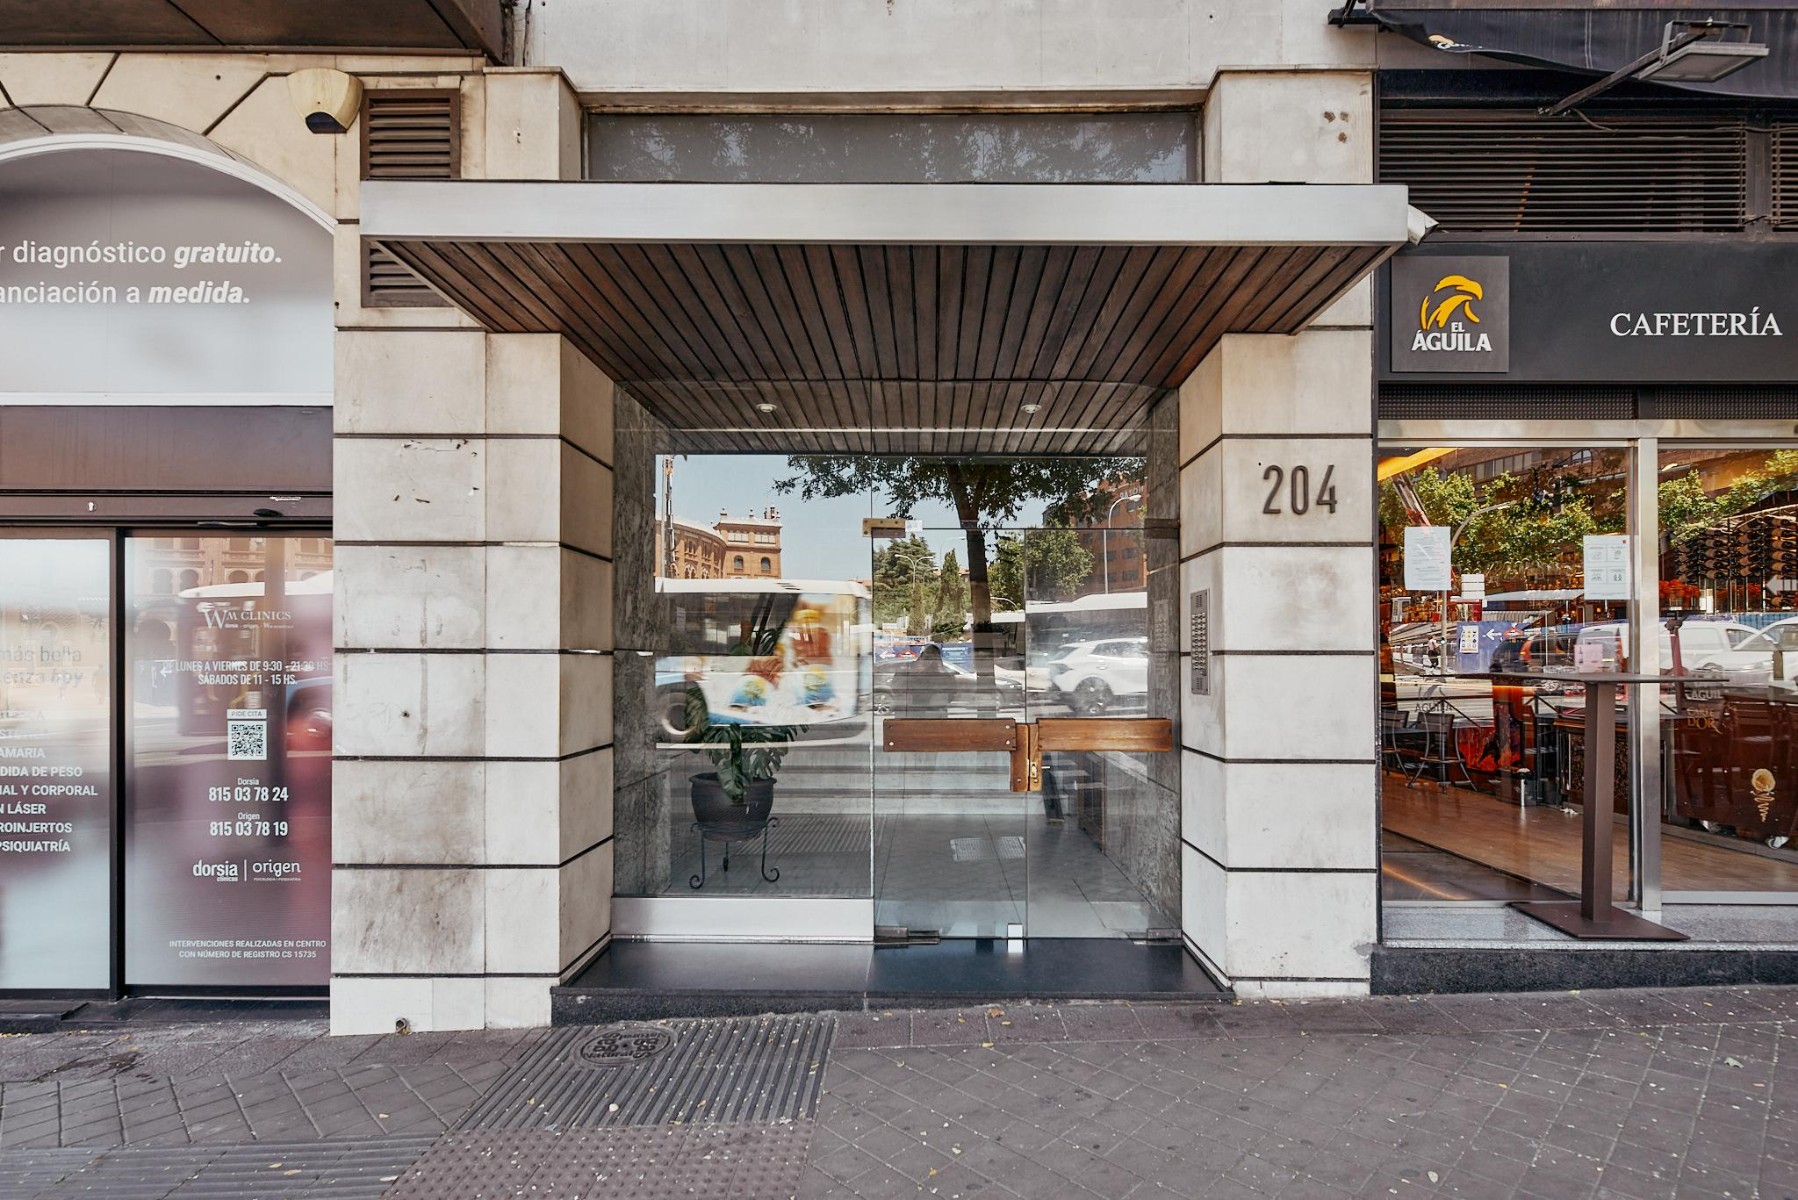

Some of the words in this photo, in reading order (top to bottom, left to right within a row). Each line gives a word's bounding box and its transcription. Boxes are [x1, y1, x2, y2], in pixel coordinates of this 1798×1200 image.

[12, 240, 167, 269] diagnóstico
[173, 240, 282, 269] gratuito.
[126, 286, 141, 304] a
[148, 280, 250, 304] medida.
[1451, 322, 1465, 333] EL
[1609, 306, 1783, 337] CAFETERÍA
[1411, 329, 1493, 353] ÁGUILA
[1262, 464, 1338, 516] 204
[240, 610, 292, 621] CLINICS
[176, 660, 203, 672] LUNES
[204, 661, 211, 672] A
[249, 660, 261, 672] DE
[198, 671, 239, 685] SÁBADOS
[240, 674, 251, 685] DE
[253, 674, 263, 685] 11
[270, 674, 282, 685] 15
[283, 674, 298, 686] HS.
[31, 766, 48, 777] DE
[50, 766, 83, 777] PESO
[237, 777, 260, 786] Dorsia
[20, 785, 29, 796] Y
[31, 785, 98, 796] CORPORAL
[208, 786, 232, 802] 815
[234, 786, 251, 802] 03
[253, 786, 269, 802] 78
[271, 786, 289, 802] 24
[7, 801, 47, 815] LÁSER
[237, 812, 261, 822] Origen
[209, 821, 232, 837] 815
[235, 821, 252, 837] 03
[255, 821, 270, 837] 78
[273, 821, 288, 837] 19
[192, 859, 239, 877] dorsia
[252, 859, 302, 878] origen
[168, 940, 235, 948] INTERVENCIONES
[235, 940, 282, 948] REALIZADAS
[283, 940, 294, 948] EN
[295, 940, 327, 948] CENTRO
[178, 950, 196, 958] CON
[197, 949, 231, 958] NÚMERO
[231, 950, 242, 958] DE
[243, 950, 281, 958] REGISTRO
[281, 950, 292, 958] CS
[294, 950, 317, 958] 15735
